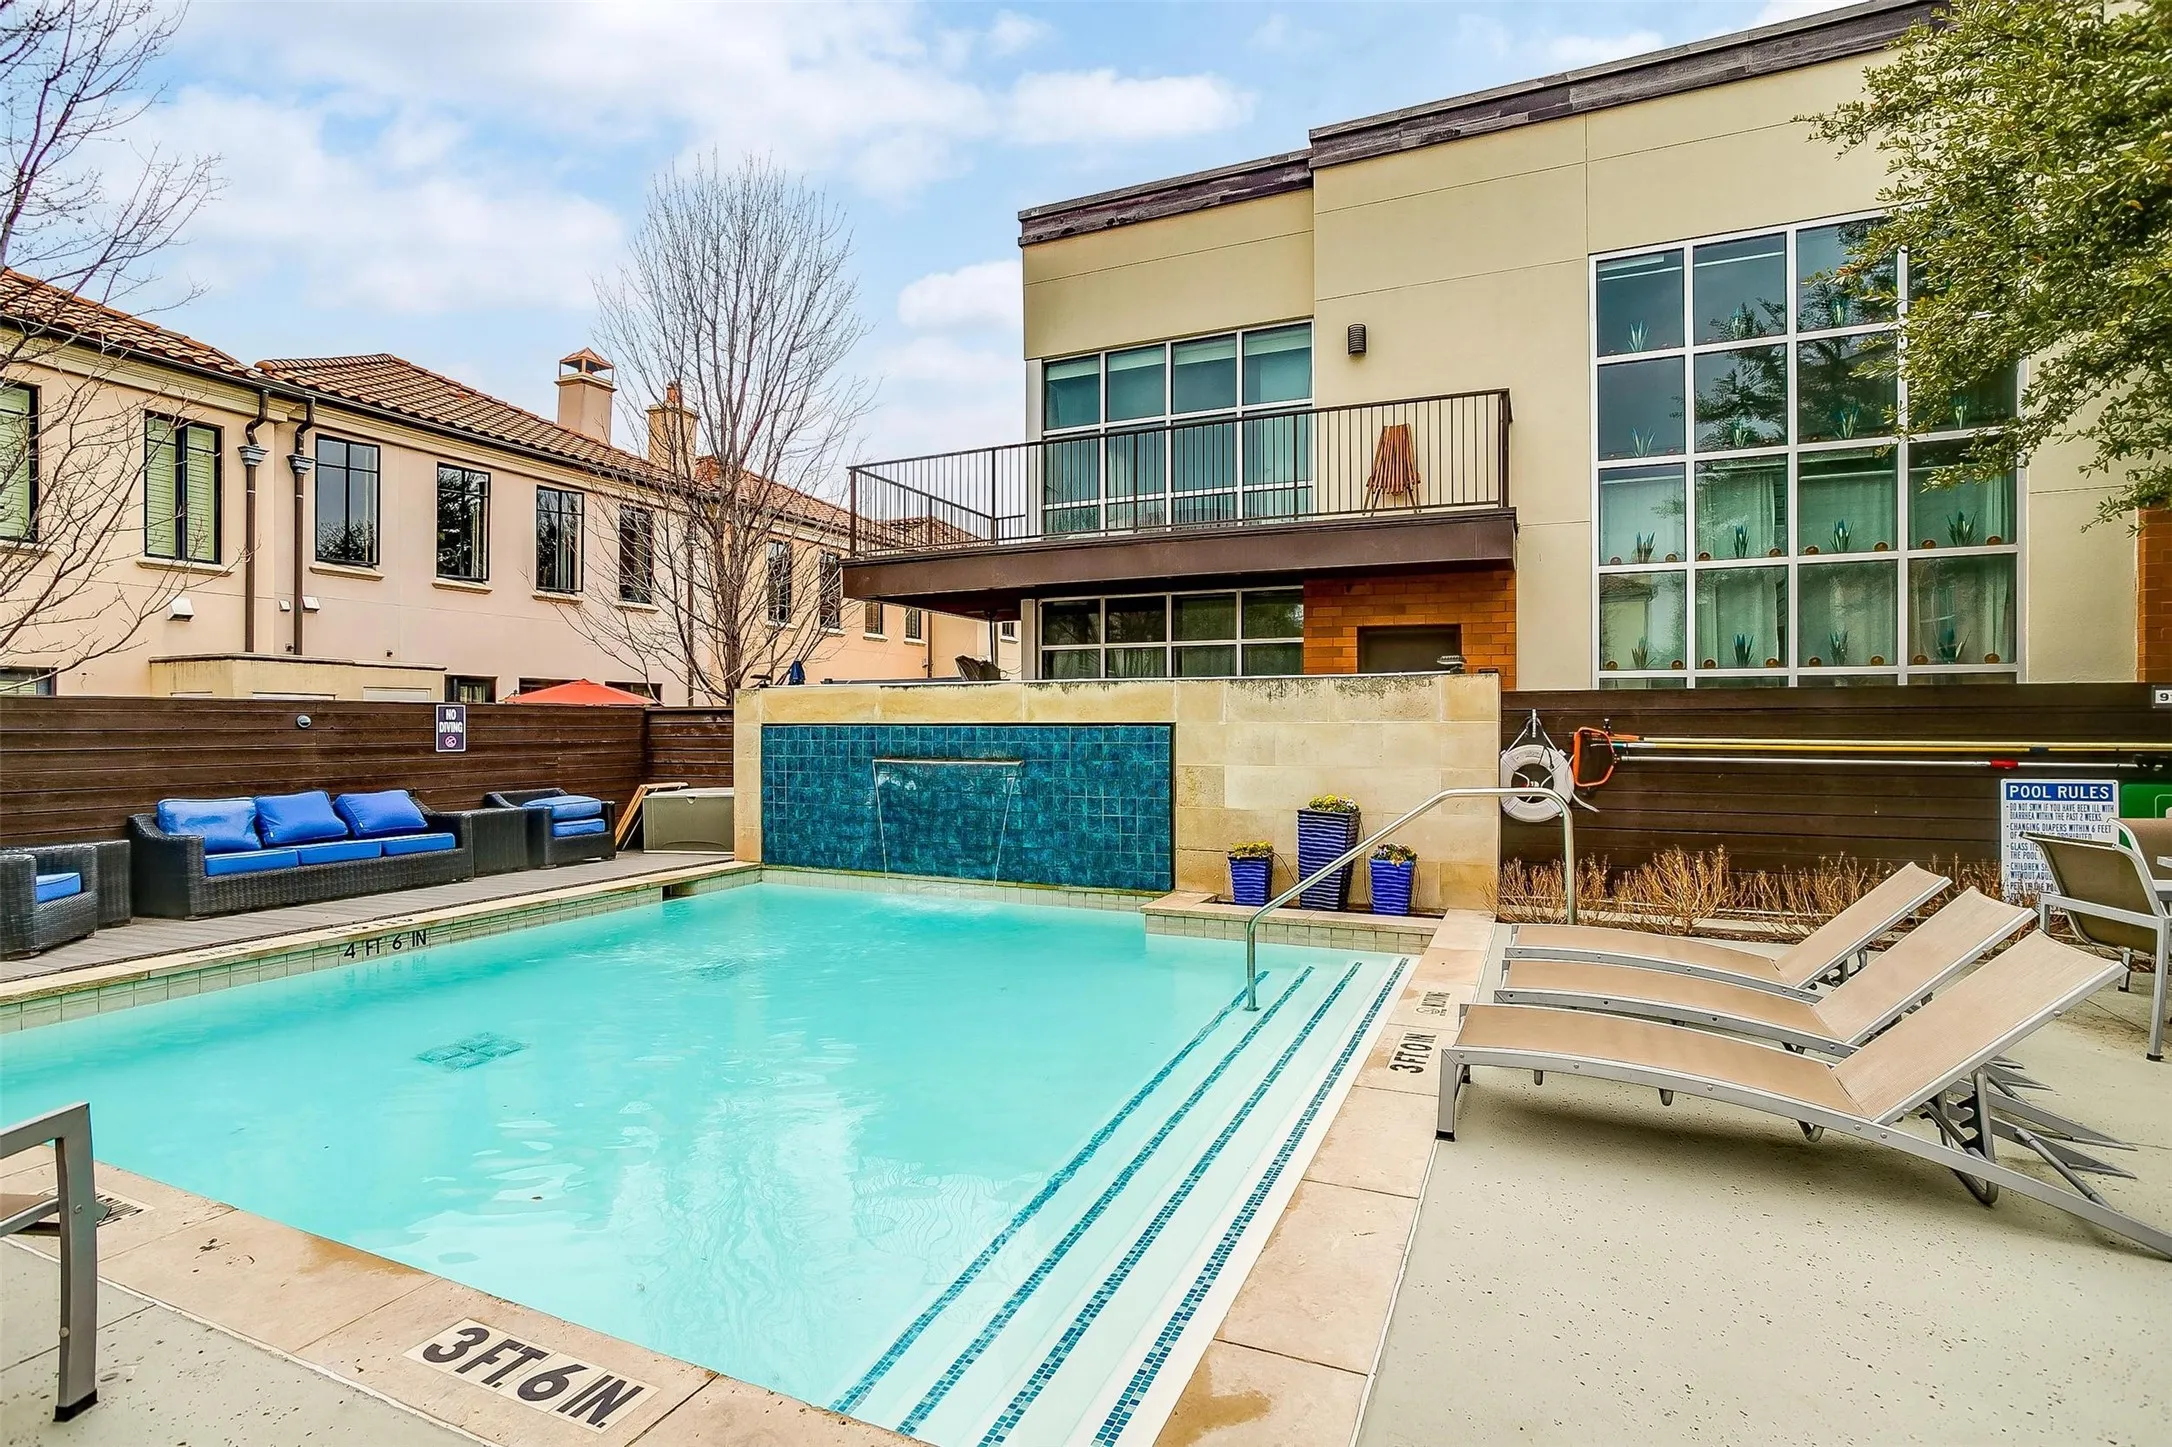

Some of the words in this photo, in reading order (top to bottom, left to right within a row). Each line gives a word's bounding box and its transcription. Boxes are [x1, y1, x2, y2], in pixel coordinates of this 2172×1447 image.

[445, 708, 457, 720] NO
[439, 721, 463, 733] DIVING
[2010, 785, 2051, 799] POOL
[2058, 785, 2109, 799] RULES
[2010, 803, 2017, 811] DO
[2019, 803, 2028, 811] NOT
[2029, 803, 2042, 811] SWIM
[2043, 803, 2049, 811] IF
[2050, 803, 2060, 812] YOU
[2062, 804, 2075, 812] HAVE
[2077, 804, 2090, 812] BEEN
[2091, 804, 2100, 812] ILL
[2101, 804, 2114, 813] WITH
[2010, 811, 2035, 820] DIARRHEA
[2036, 812, 2054, 820] WITHIN
[2055, 812, 2065, 820] THE
[2066, 813, 2079, 821] PAST
[2080, 813, 2084, 821] 2
[2010, 822, 2040, 831] CHANGING
[2042, 823, 2067, 832] DIAPERS
[2069, 824, 2090, 833] WITHIN
[2091, 824, 2096, 833] 6
[2097, 825, 2112, 834] FEET
[2010, 831, 2017, 840] OF
[2010, 842, 2029, 851] GLASS
[2010, 850, 2021, 860] THE
[2023, 851, 2039, 860] POOL
[2010, 862, 2040, 871] CHILDREN
[344, 942, 356, 959] 4
[365, 938, 382, 956] FT
[392, 934, 402, 950] 6
[411, 929, 427, 947] IN
[1389, 1063, 1424, 1074] 3
[422, 1327, 490, 1363] 3
[455, 1338, 550, 1388] FT.
[517, 1363, 588, 1402] 6
[556, 1374, 645, 1428] IN.
